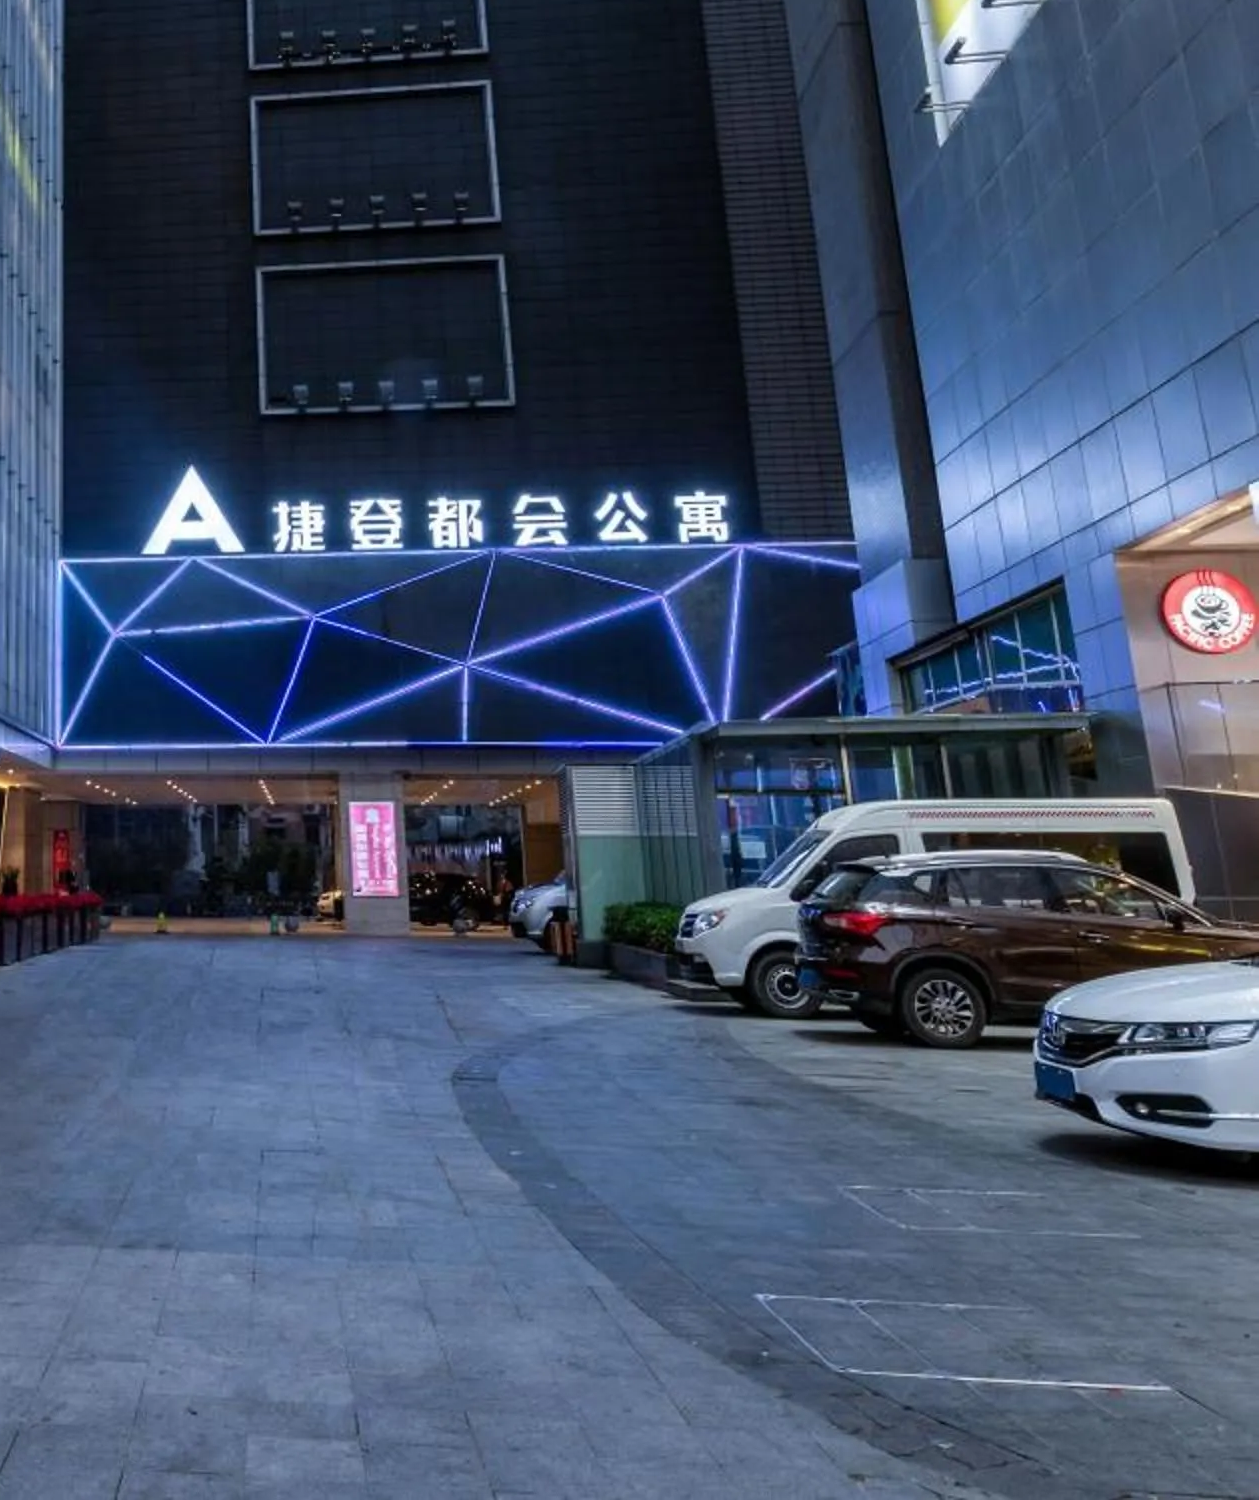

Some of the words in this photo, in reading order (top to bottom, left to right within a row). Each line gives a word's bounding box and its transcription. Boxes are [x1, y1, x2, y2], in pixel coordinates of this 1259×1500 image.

[142, 465, 245, 555] A
[272, 491, 729, 553] 捷登都会公寓
[1168, 613, 1215, 650] PACIFIC
[1219, 612, 1256, 650] COFFEE
